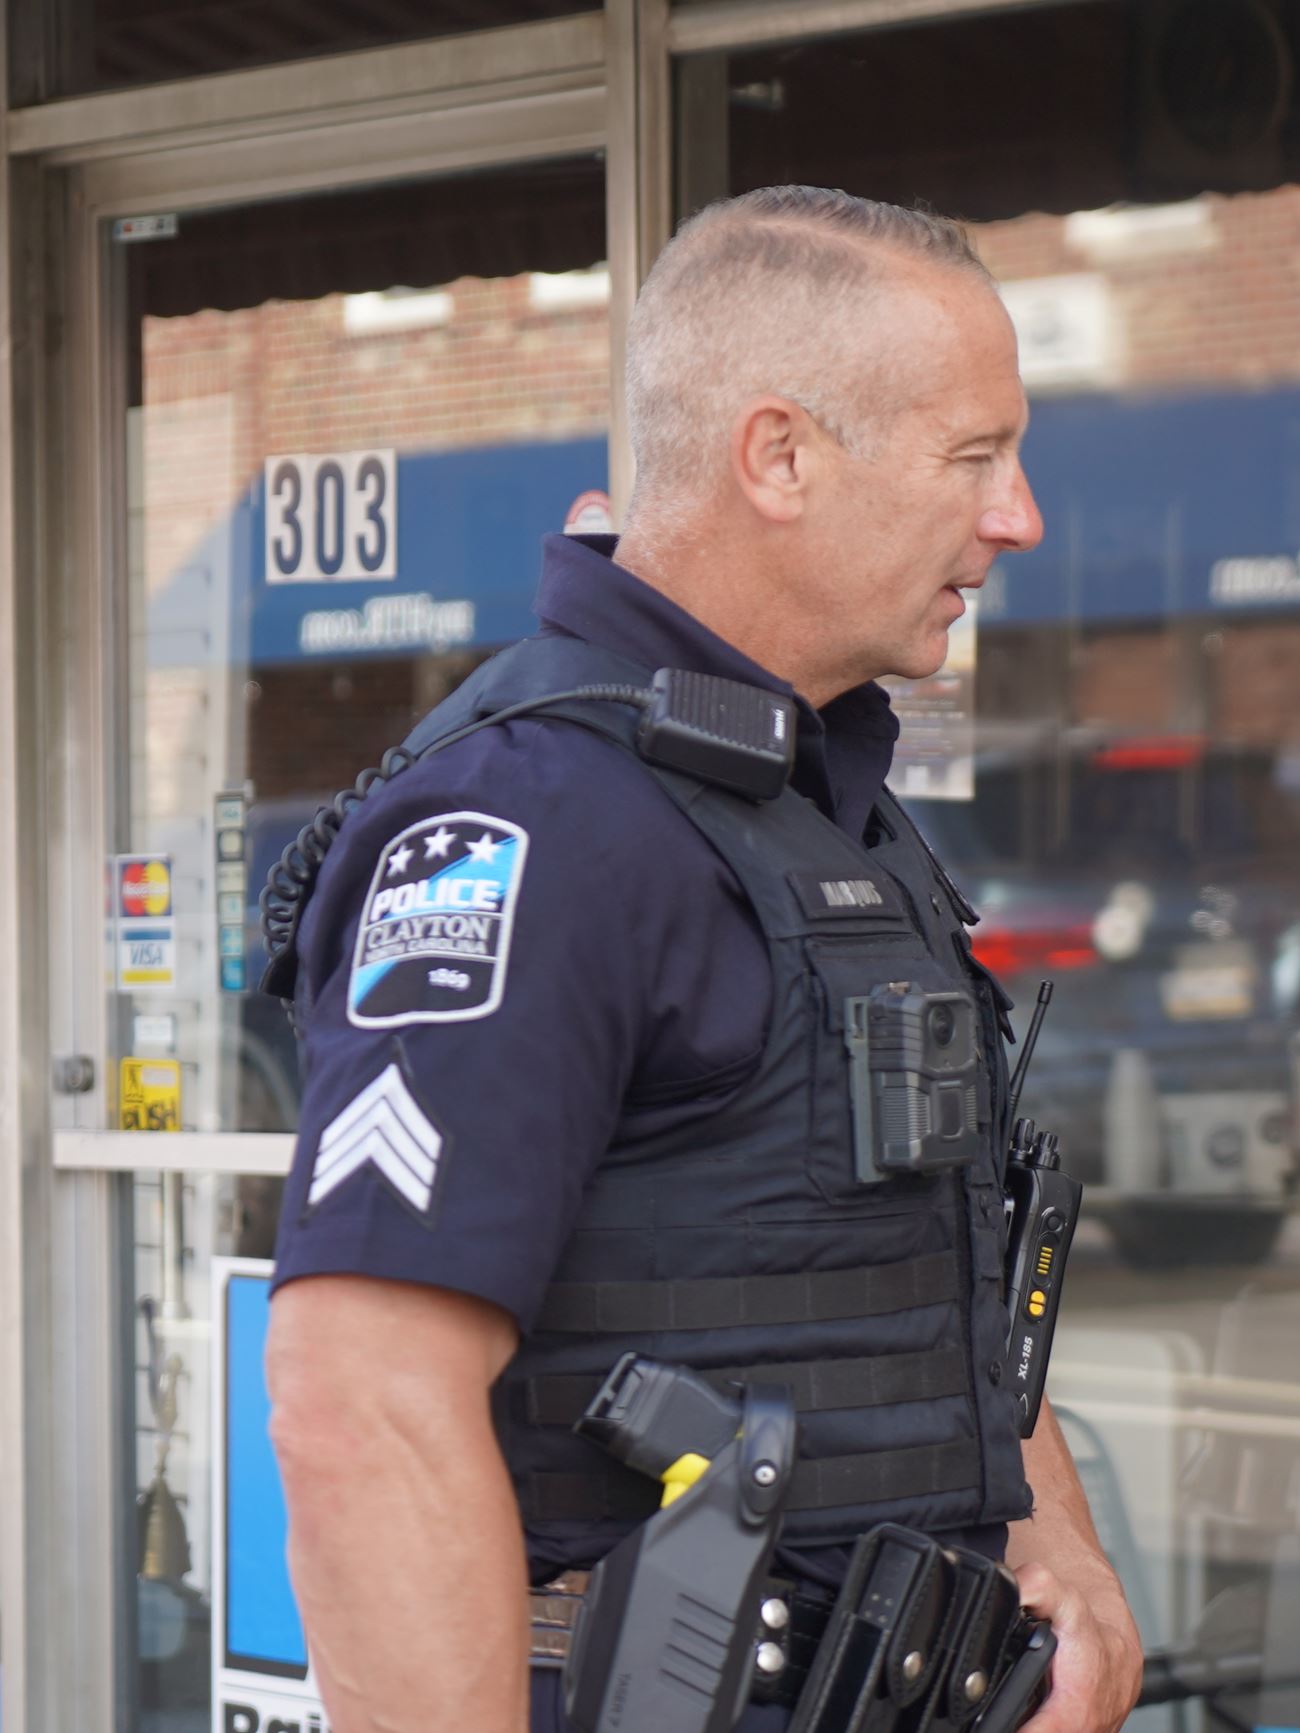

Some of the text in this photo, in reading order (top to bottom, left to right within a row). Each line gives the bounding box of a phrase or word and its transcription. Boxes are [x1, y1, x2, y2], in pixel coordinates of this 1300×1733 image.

[272, 456, 387, 575] 303
[371, 878, 501, 921] POLICE
[367, 915, 491, 949] CLAYTON
[1018, 1335, 1033, 1380] XL-185
